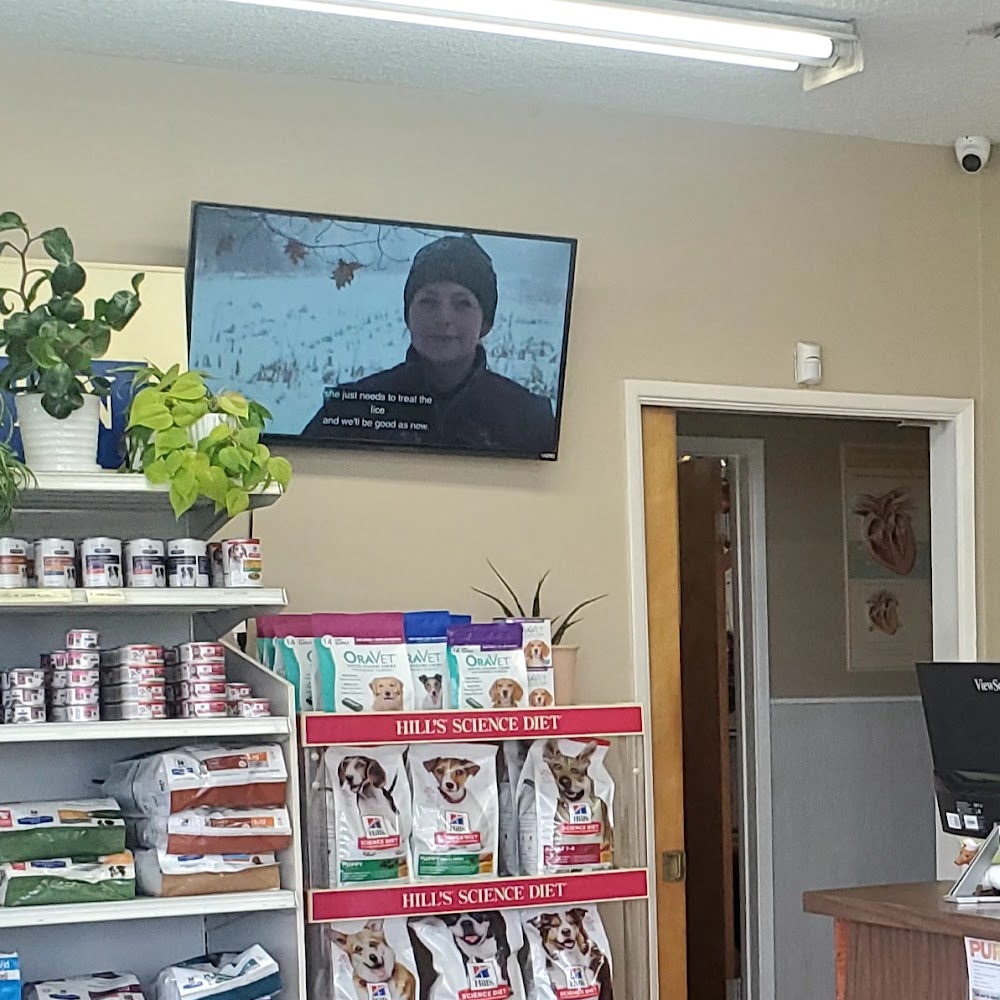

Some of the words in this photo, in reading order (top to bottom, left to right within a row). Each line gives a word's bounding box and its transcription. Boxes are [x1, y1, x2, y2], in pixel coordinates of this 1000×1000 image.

[324, 390, 340, 398] she
[342, 391, 357, 400] just
[360, 393, 386, 401] needs
[388, 394, 396, 402] to
[398, 394, 417, 403] treat
[419, 396, 432, 404] the
[370, 405, 385, 414] lice
[322, 417, 340, 425] and
[362, 418, 372, 427] be
[375, 420, 396, 430] good
[395, 718, 447, 735] HILL'S
[452, 716, 519, 734] SCIENCE
[523, 715, 561, 731] DIET
[402, 891, 453, 908] HILL'S
[458, 886, 524, 905] SCIENCE
[529, 882, 567, 899] DIET
[461, 990, 492, 1000] SCIENCE
[492, 988, 507, 996] DIET
